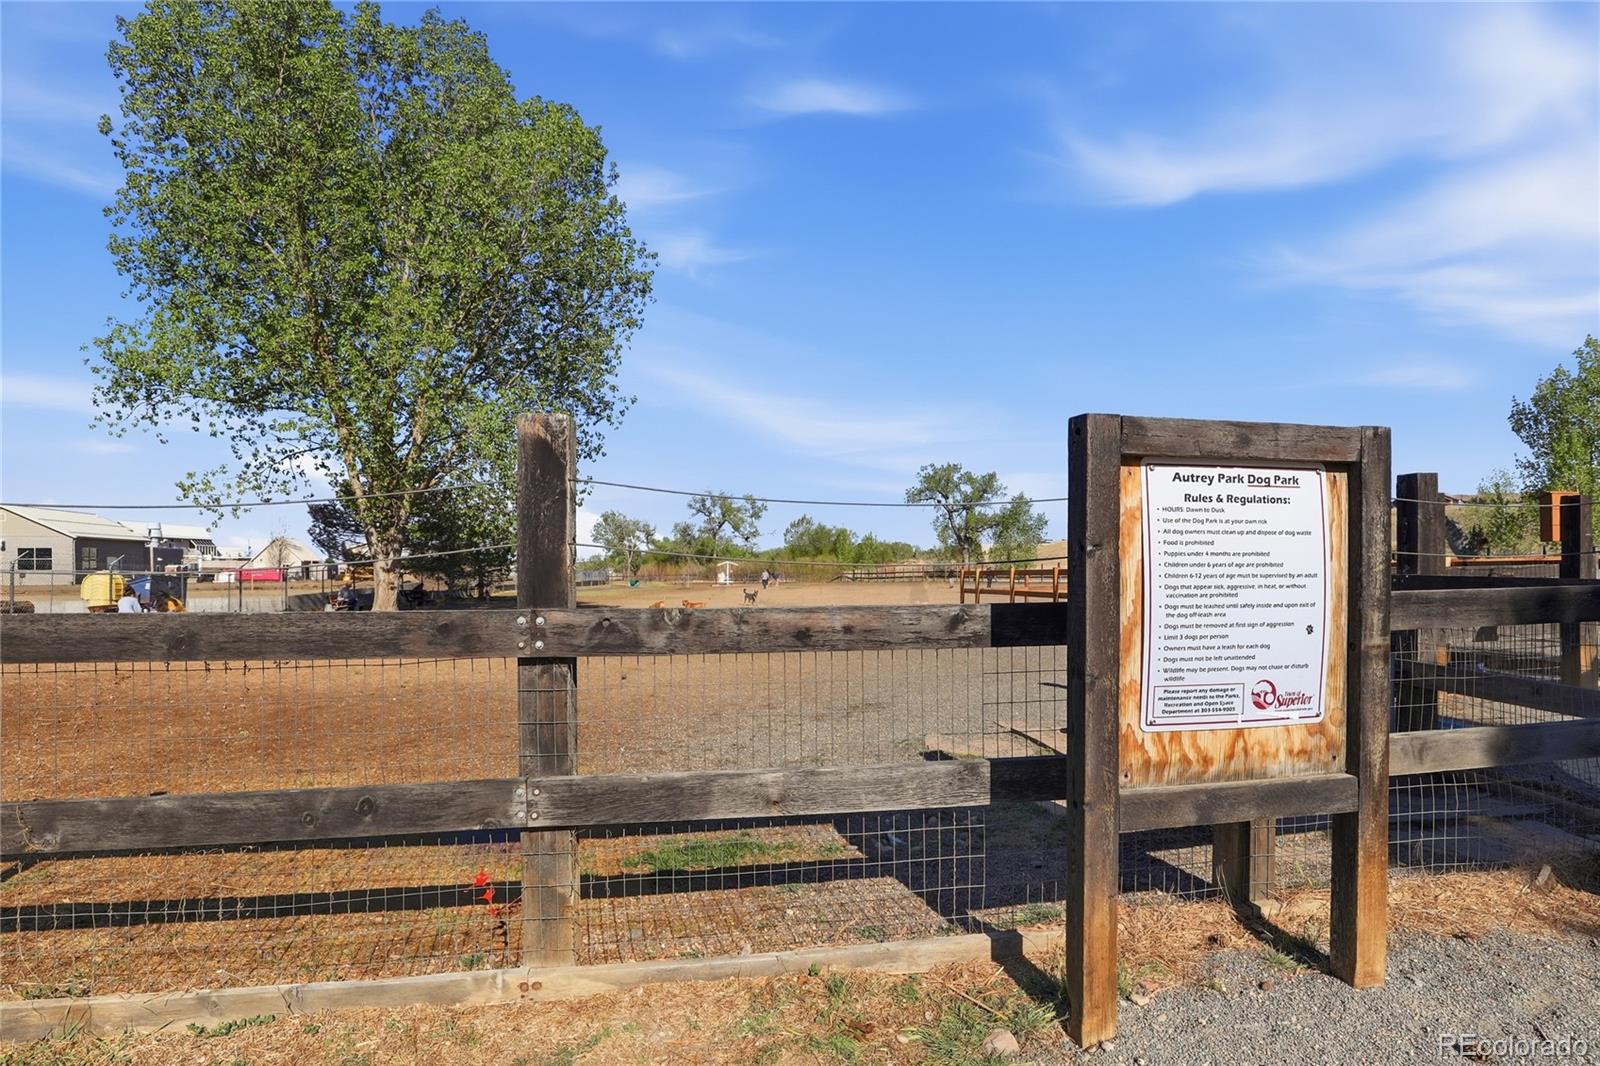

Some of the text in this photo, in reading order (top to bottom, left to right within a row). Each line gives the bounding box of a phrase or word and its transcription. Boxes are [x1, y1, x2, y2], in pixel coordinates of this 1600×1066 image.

[1172, 472, 1299, 487] Autrey Park Dog Park
[1184, 494, 1290, 505] Rules & Regulations:
[1274, 693, 1313, 709] Superior
